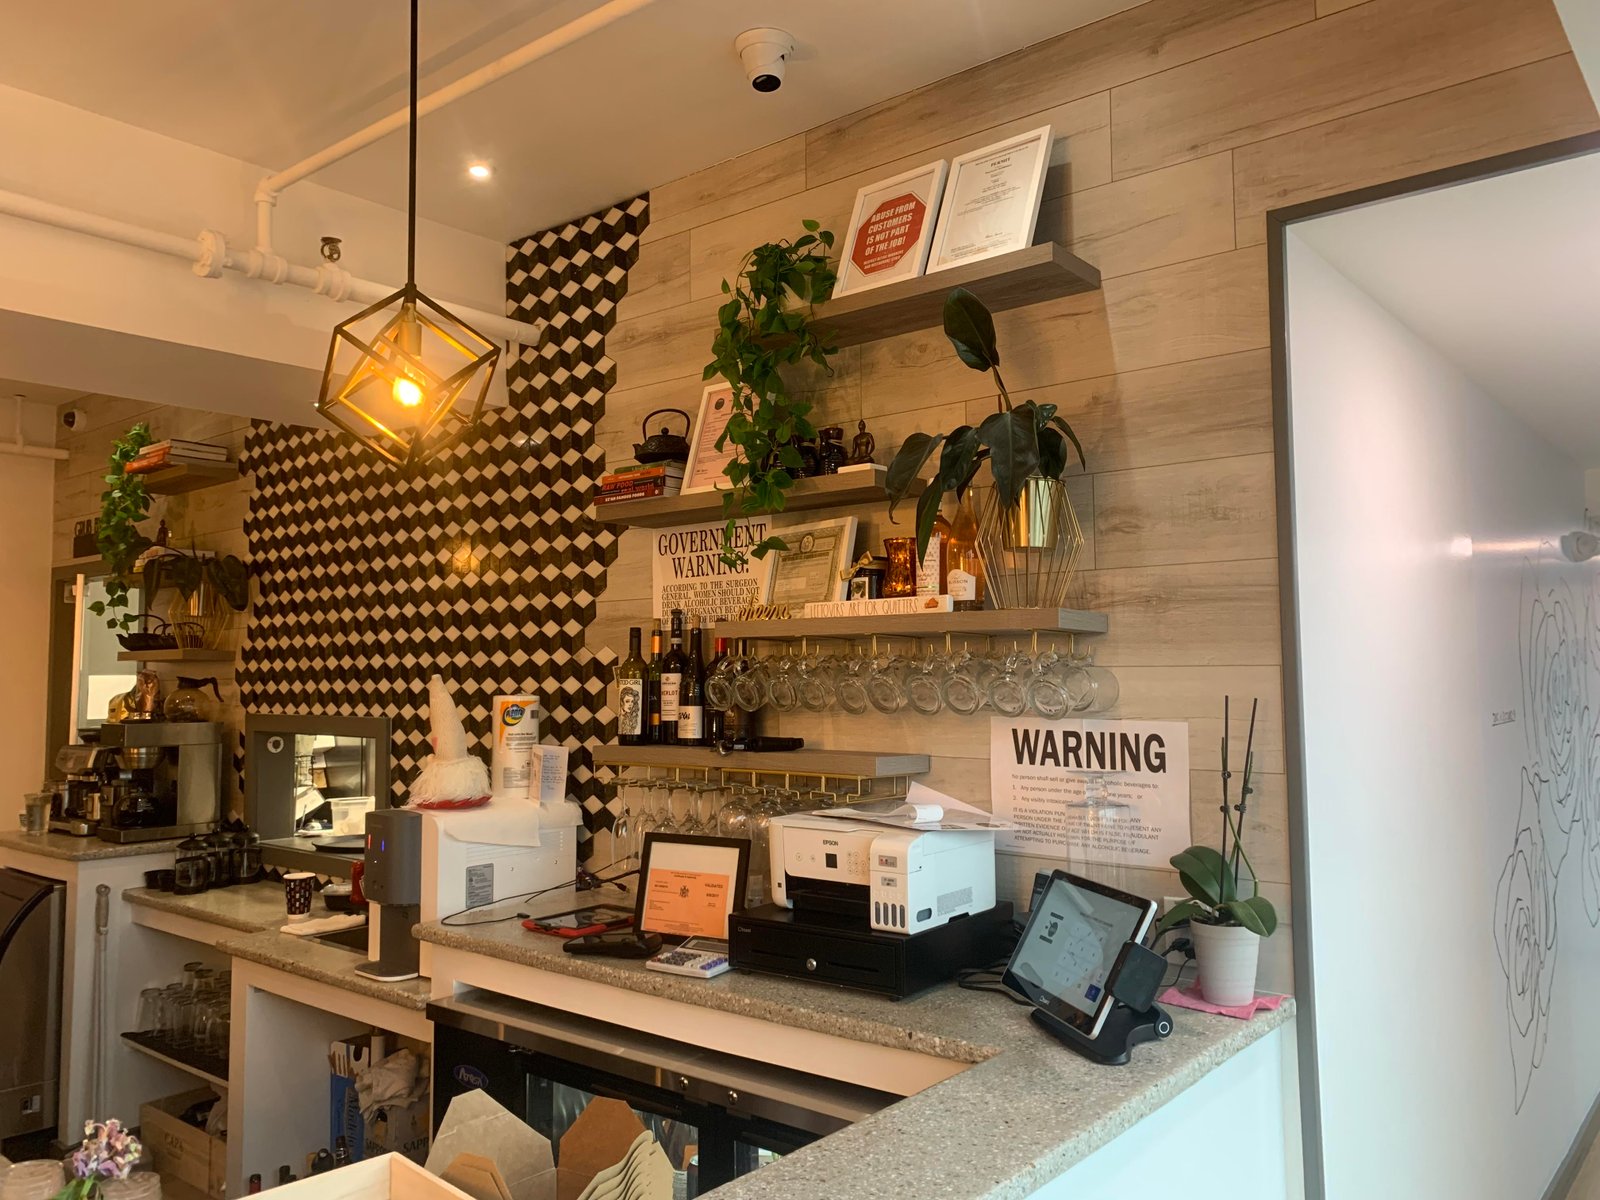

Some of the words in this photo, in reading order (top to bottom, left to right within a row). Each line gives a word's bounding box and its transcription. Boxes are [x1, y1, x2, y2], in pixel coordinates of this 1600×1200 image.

[870, 208, 895, 223] ABUSE
[894, 201, 916, 214] FROM
[868, 213, 913, 234] CUSTOMERS
[866, 235, 875, 245] IS
[875, 230, 890, 242] NOT
[890, 224, 910, 237] PART
[865, 246, 875, 256] OF
[875, 241, 889, 255] THE
[889, 236, 906, 249] JOB!
[662, 582, 697, 593] ACCORDING
[700, 582, 708, 590] TO
[710, 581, 723, 589] THE
[726, 578, 758, 588] SURGEON
[694, 589, 716, 599] WOMEN
[718, 588, 744, 597] SHOULD
[746, 587, 760, 596] NOT
[662, 600, 681, 609] DRINK
[684, 598, 719, 607] ALCOHOLIC
[686, 606, 722, 616] PREGNANCY
[810, 603, 845, 618] LEFTOVERS
[848, 602, 860, 616] ARE
[864, 601, 878, 615] FOR
[882, 598, 919, 614] QUITTERS
[1011, 728, 1167, 774] WARNING
[1124, 781, 1151, 789] beverages
[1014, 835, 1044, 844] ATTEMPTING
